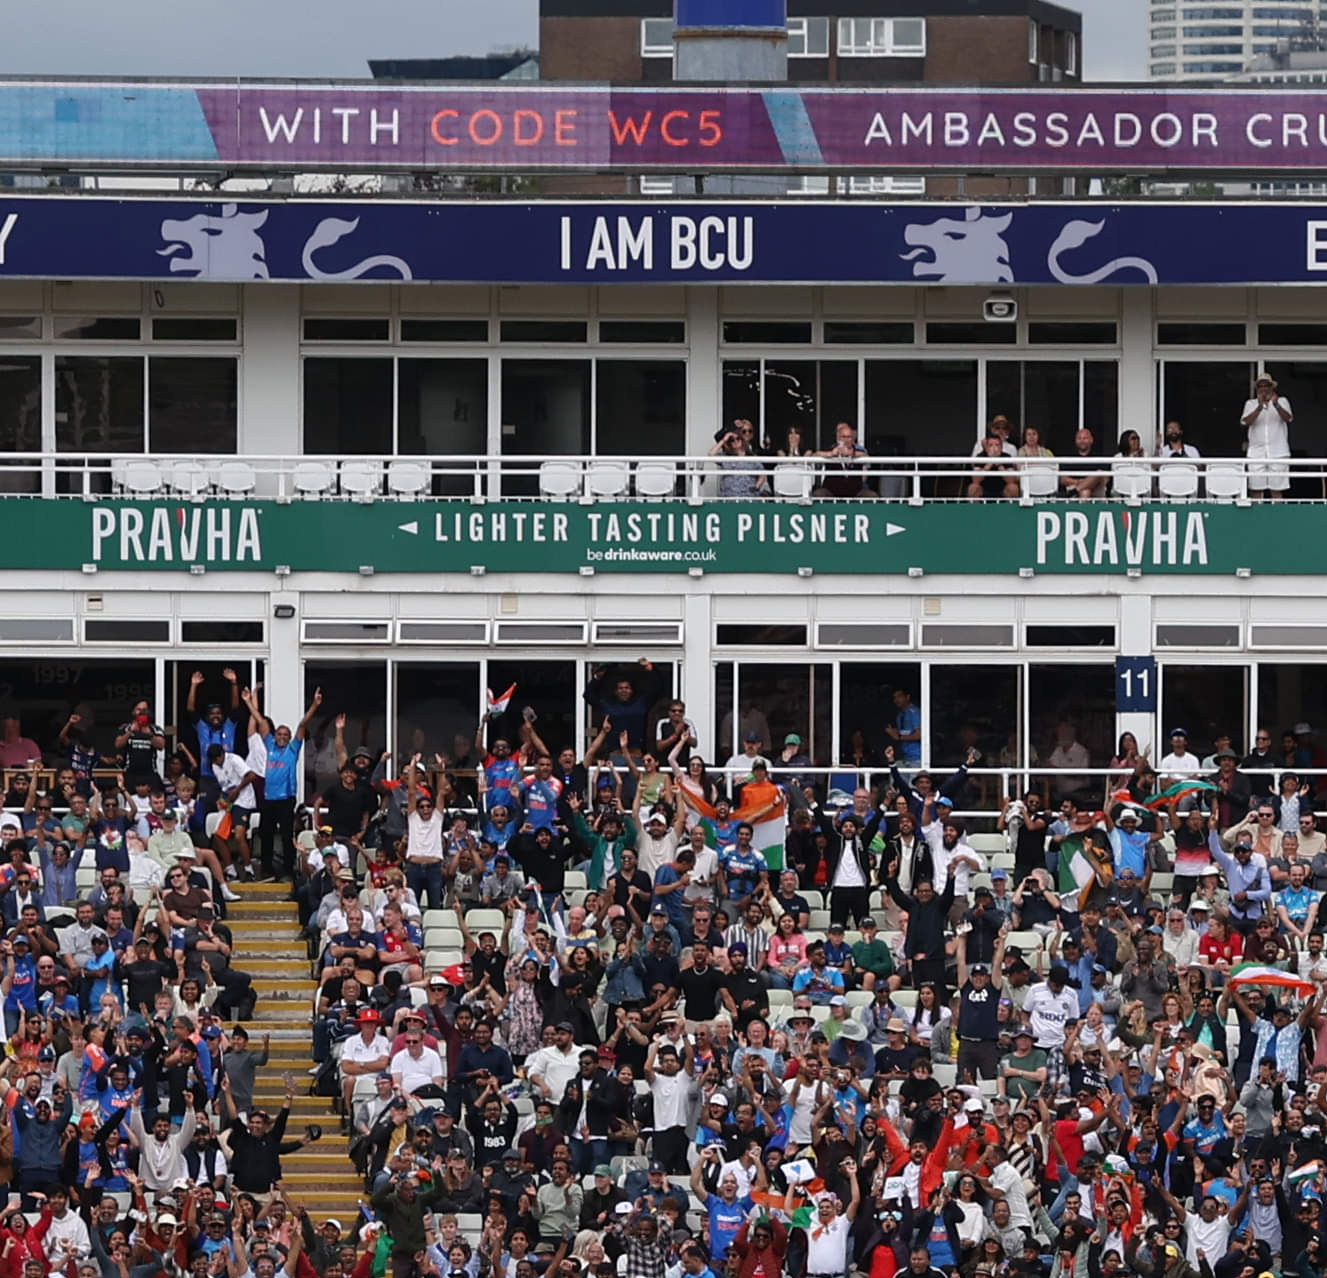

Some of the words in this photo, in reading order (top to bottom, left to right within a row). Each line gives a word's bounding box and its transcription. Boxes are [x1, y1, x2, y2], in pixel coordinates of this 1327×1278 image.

[259, 107, 399, 145] WITH
[430, 108, 577, 146] CODE
[607, 109, 723, 147] WC5
[864, 112, 1219, 147] AMBASSADOR
[561, 216, 571, 270] I
[586, 216, 653, 270] AM
[671, 216, 753, 270] BCU
[92, 508, 262, 563] PRAVHA
[435, 512, 568, 542] LIGHTER
[587, 513, 721, 543] TASTING
[738, 513, 869, 543] PILSNER
[1036, 511, 1209, 565] PRAVHA
[587, 547, 717, 561] bedrinkaware.co.uk
[1120, 669, 1148, 697] 11
